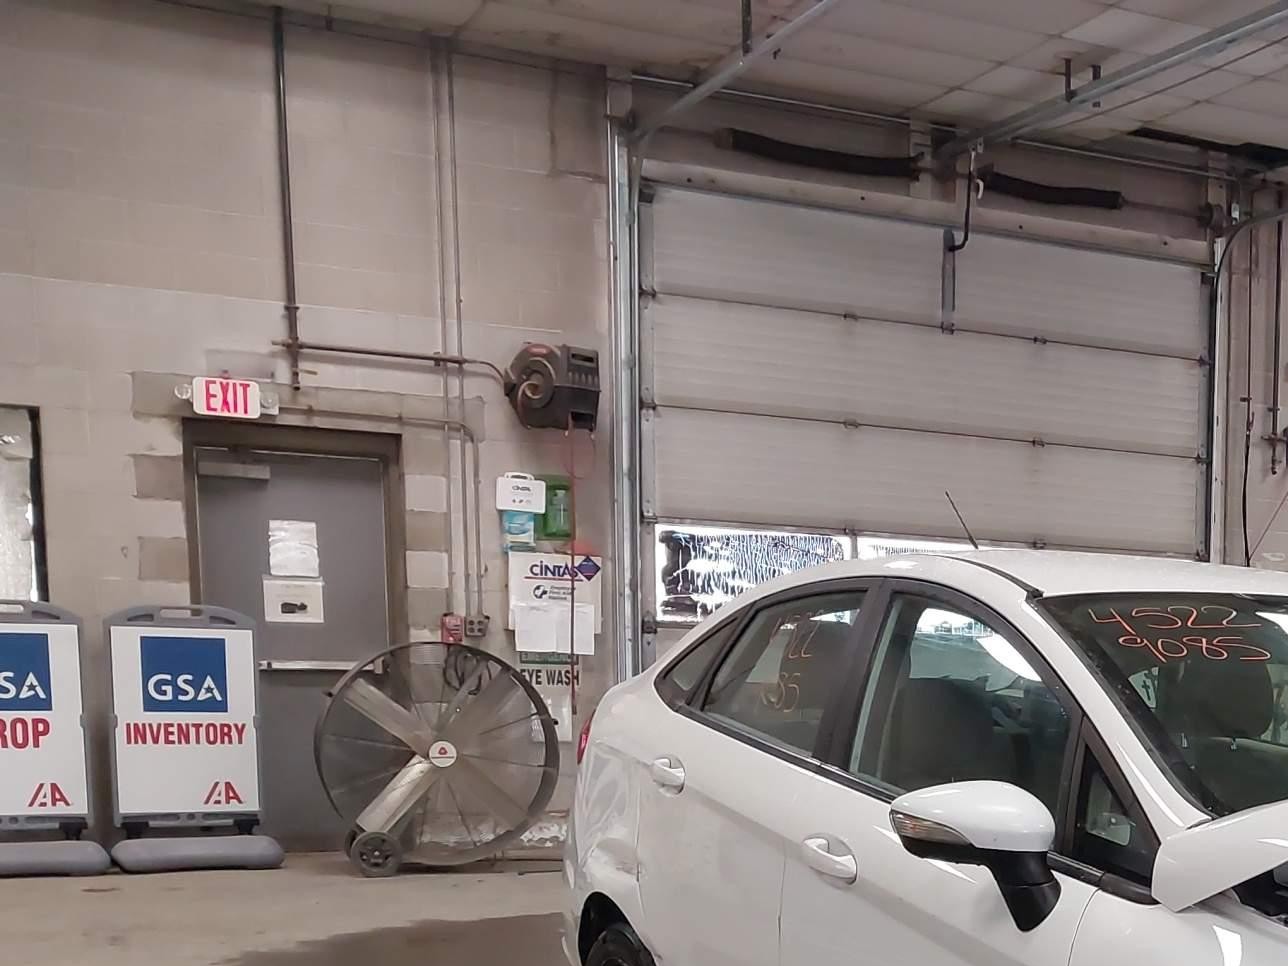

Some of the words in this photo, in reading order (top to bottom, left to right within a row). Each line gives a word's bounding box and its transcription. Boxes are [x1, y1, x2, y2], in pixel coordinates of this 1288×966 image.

[205, 379, 250, 415] EXIT
[1088, 605, 1262, 635] 4522
[1118, 636, 1271, 663] 9085
[147, 673, 222, 701] GSA
[546, 668, 580, 686] WASH
[125, 722, 247, 745] INVENTORY
